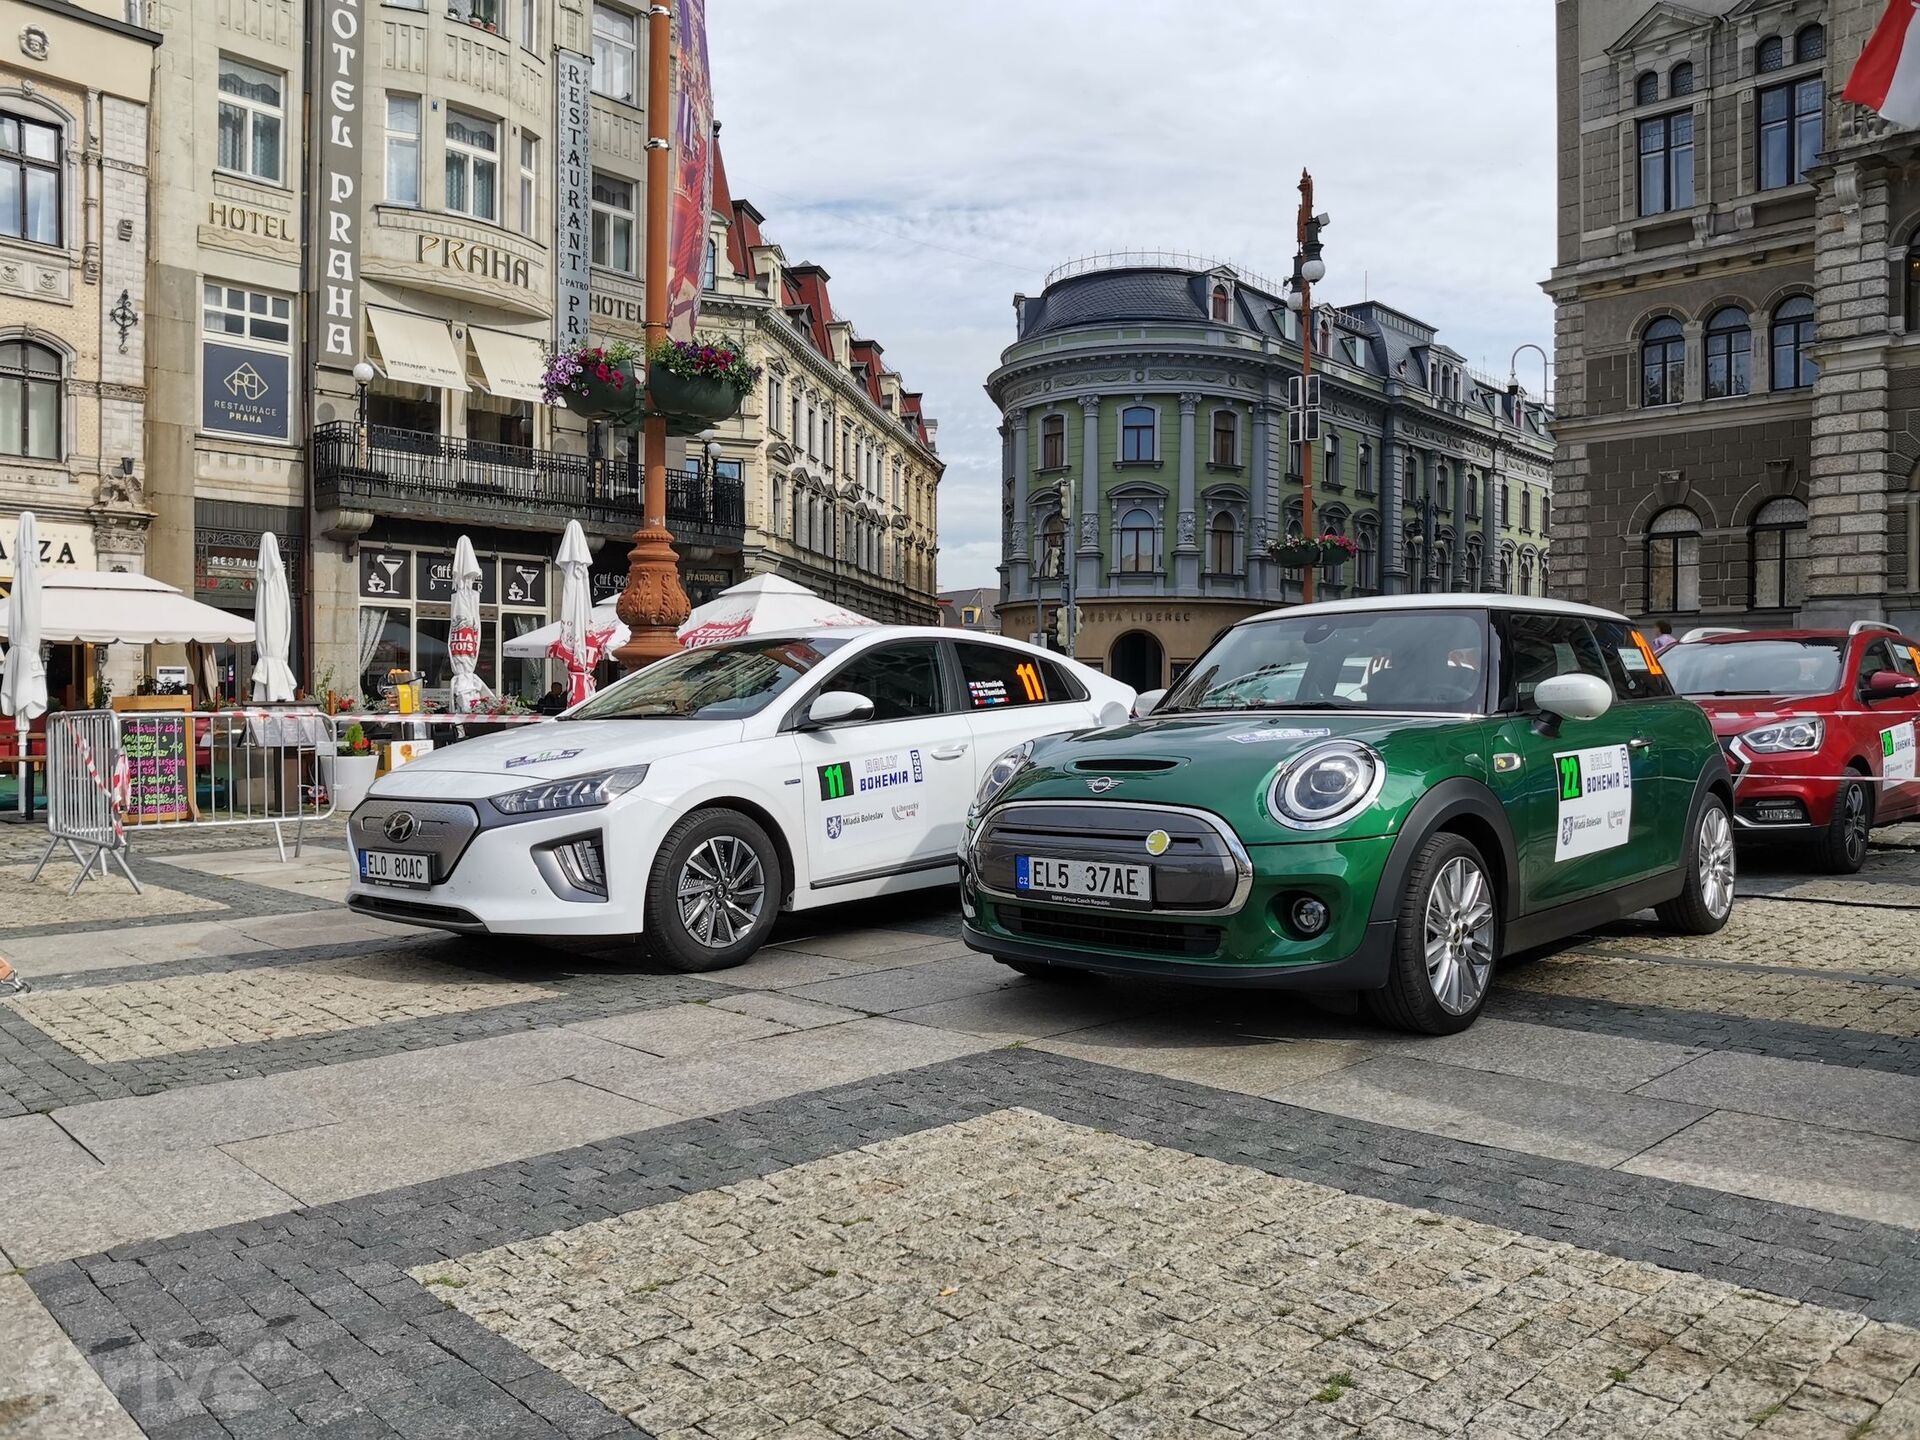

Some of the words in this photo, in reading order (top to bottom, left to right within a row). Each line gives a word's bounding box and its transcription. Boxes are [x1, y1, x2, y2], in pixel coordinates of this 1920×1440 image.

[331, 0, 358, 148] OTEL
[567, 65, 582, 271] RESTAURANT
[209, 202, 295, 242] HOTEL
[326, 171, 353, 356] PRAHA
[416, 234, 529, 289] PRAHA
[566, 279, 589, 291] PATRO
[589, 292, 644, 324] HOTEL
[214, 400, 277, 417] RESTAURACE
[229, 412, 262, 424] PRAHA
[1130, 611, 1191, 622] LIBEREC
[693, 624, 746, 637] STELLA
[1016, 663, 1044, 700] 11
[865, 755, 897, 773] RALLY
[911, 751, 922, 782] 2020
[825, 764, 845, 798] 11
[860, 770, 909, 791] BOHEMIA
[1561, 757, 1580, 799] 22
[1587, 772, 1620, 793] BOHEMIA
[861, 811, 884, 823] Boleslav
[394, 857, 423, 879] 80AC
[1018, 876, 1028, 885] CZ
[1033, 861, 1069, 889] EL5
[1086, 866, 1139, 896] 37AE
